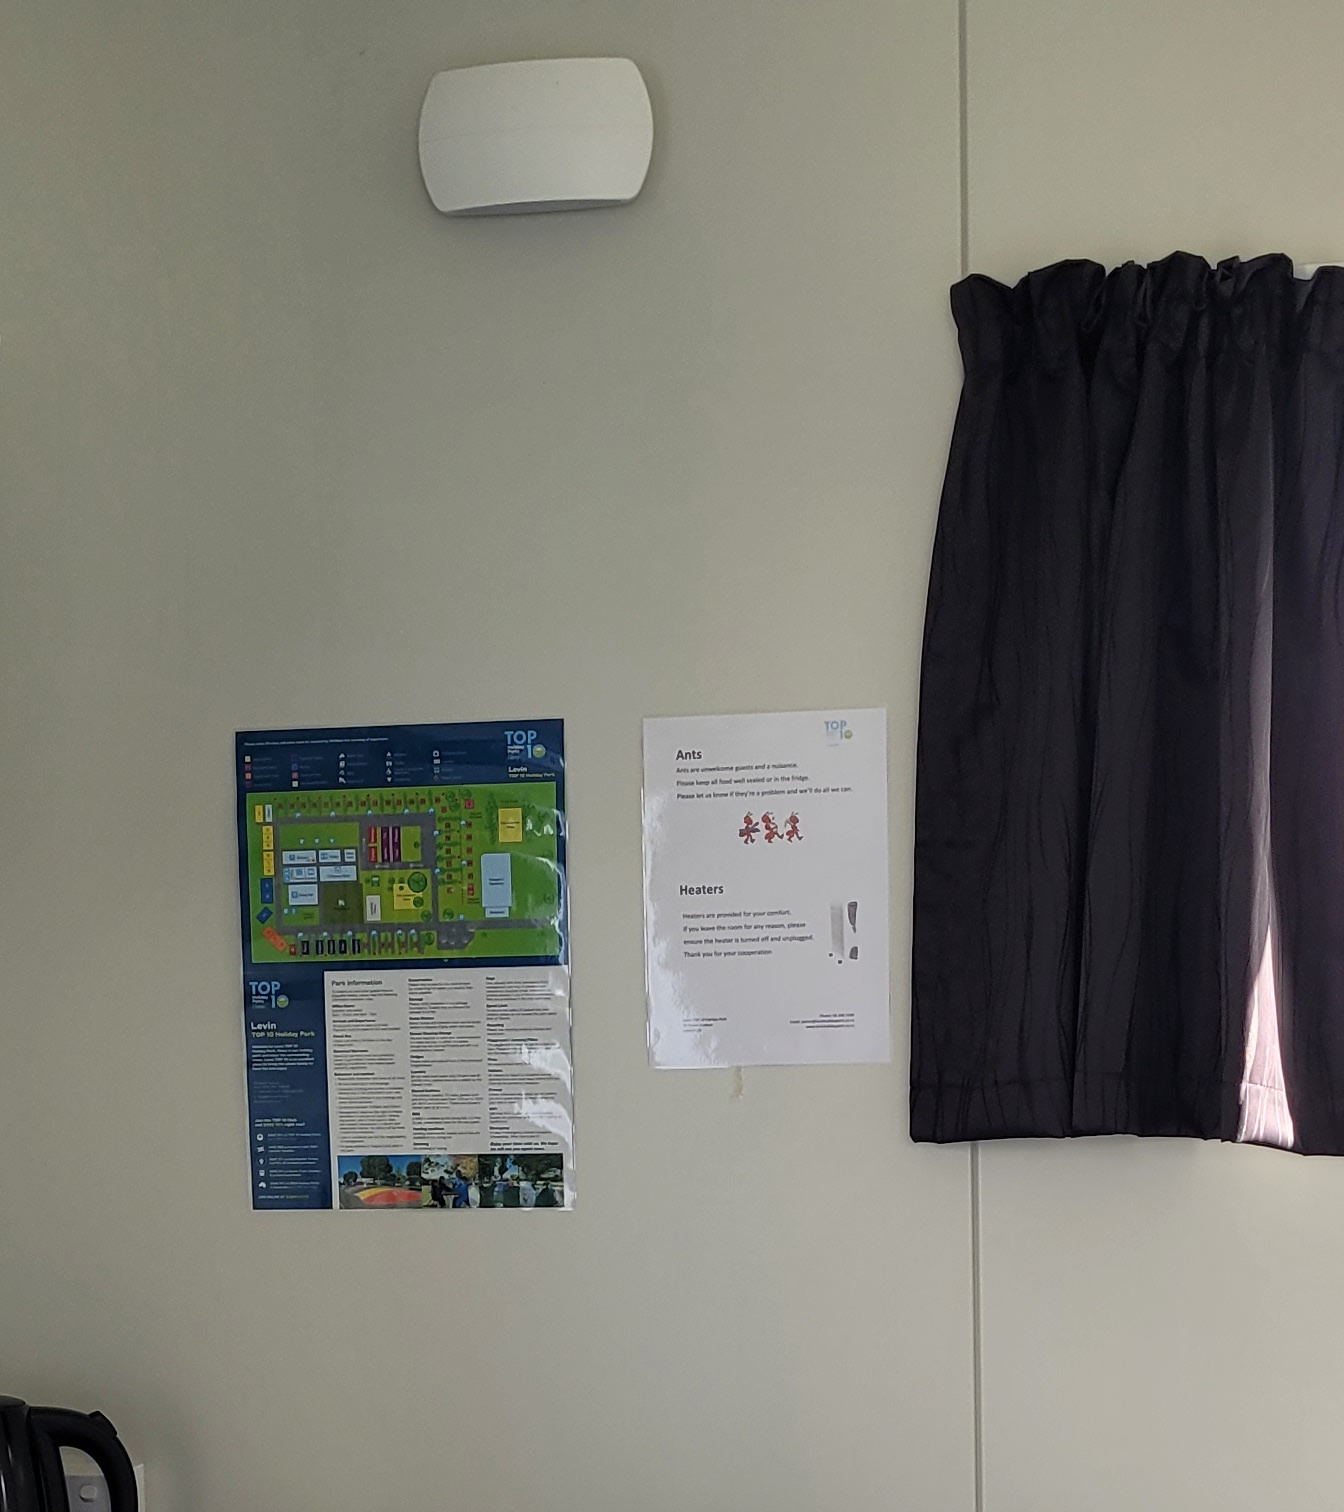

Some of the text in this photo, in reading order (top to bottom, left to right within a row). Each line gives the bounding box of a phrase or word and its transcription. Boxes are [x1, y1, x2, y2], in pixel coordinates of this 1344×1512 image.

[824, 720, 847, 731] TOP
[504, 730, 537, 745] TOP
[676, 749, 702, 760] Ants
[700, 765, 734, 773] unwelcome
[735, 765, 754, 773] guests
[761, 789, 786, 797] problem
[679, 884, 724, 896] Heaters
[716, 911, 742, 919] provided
[249, 981, 281, 995] TOP
[250, 1021, 276, 1030] Levin
